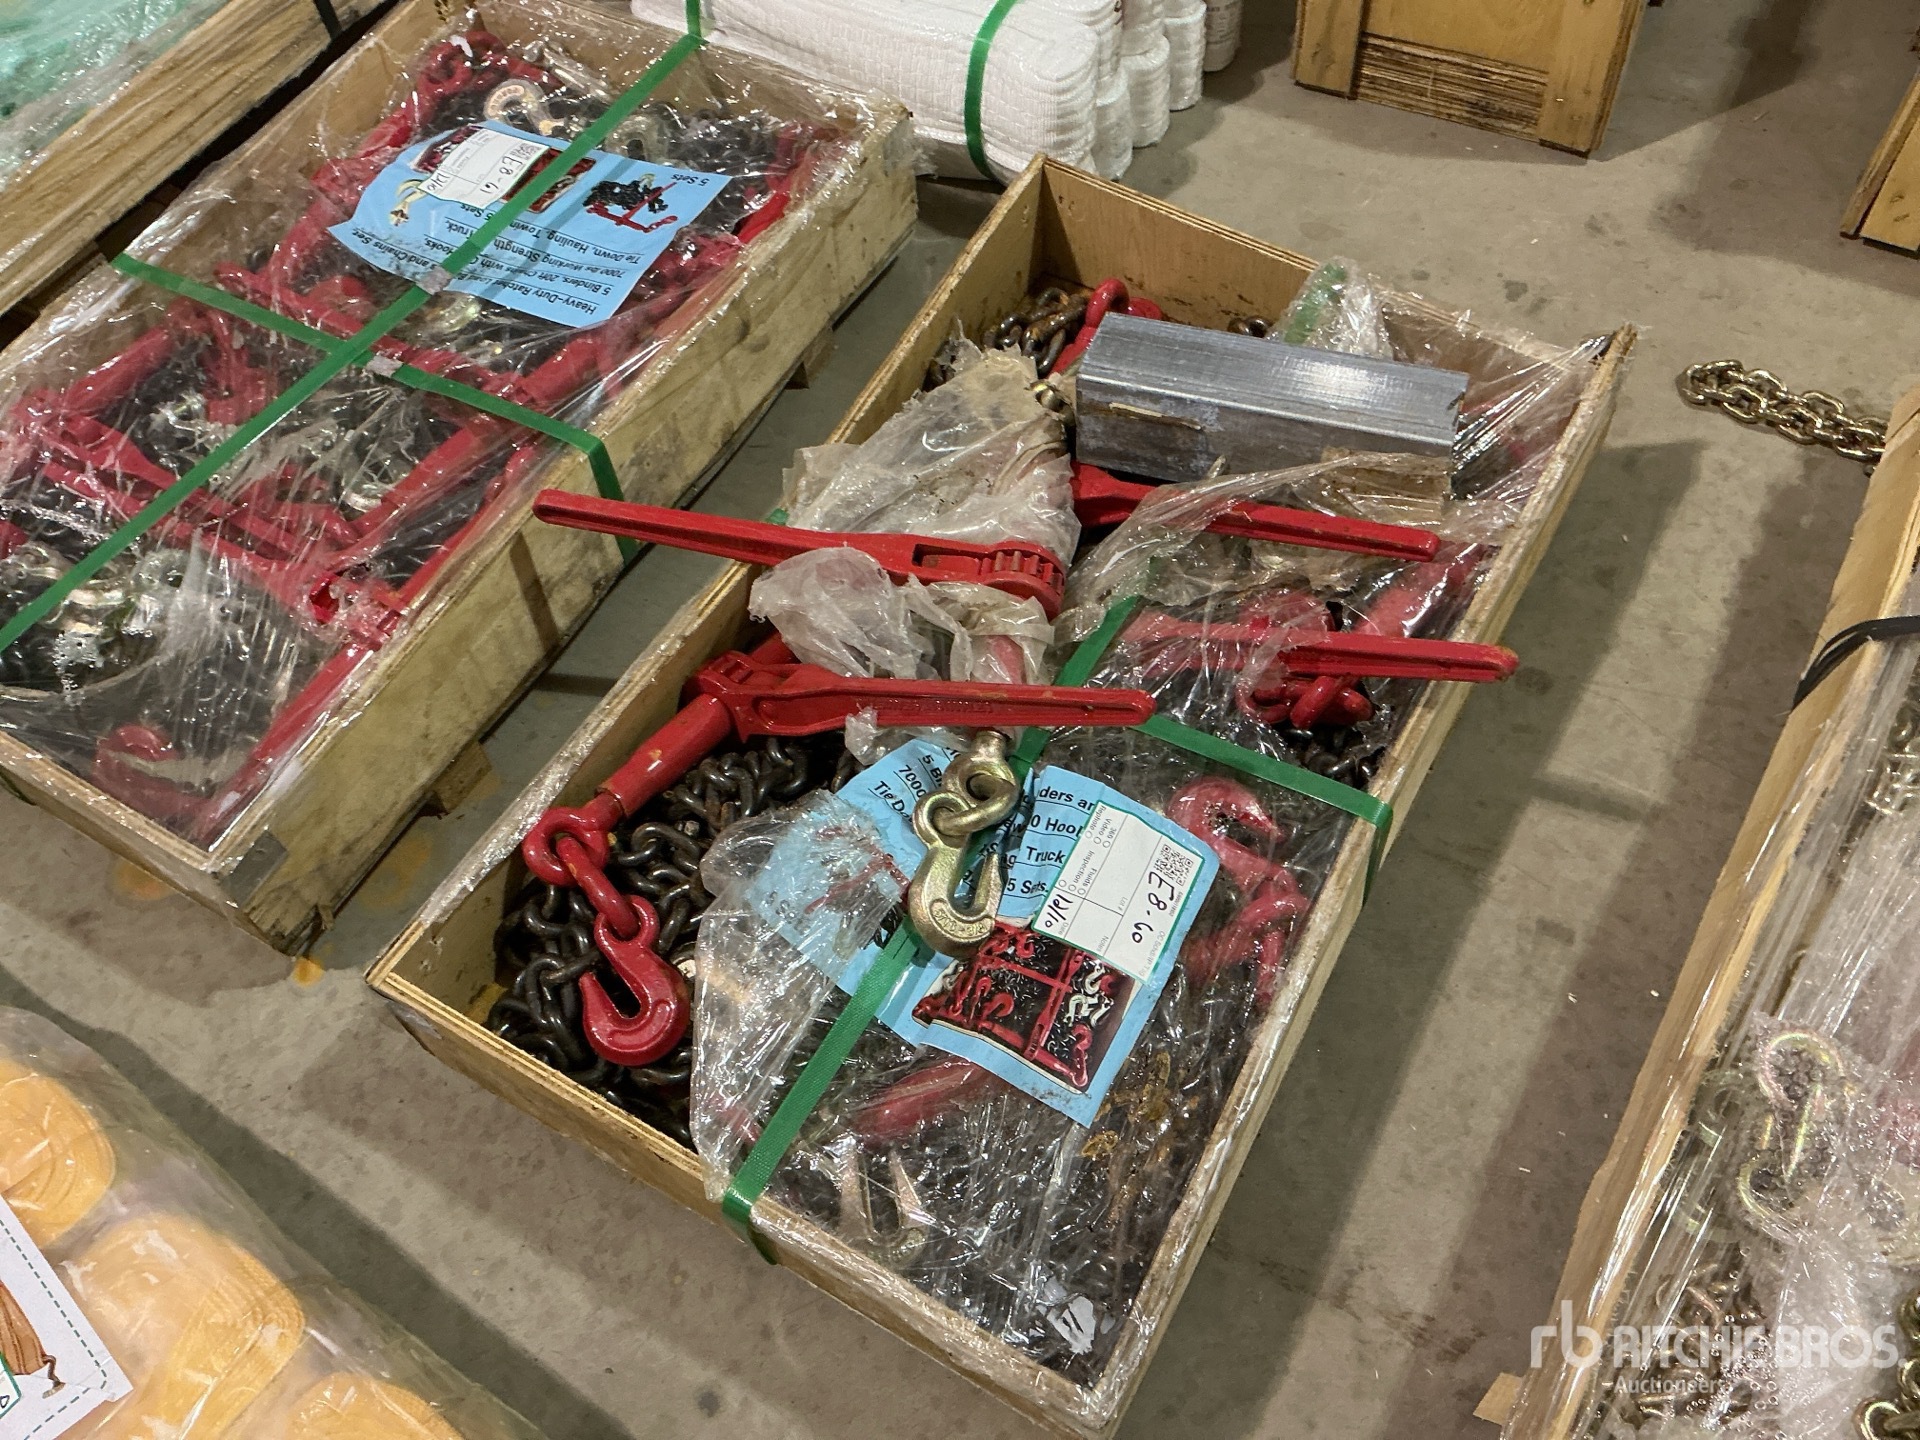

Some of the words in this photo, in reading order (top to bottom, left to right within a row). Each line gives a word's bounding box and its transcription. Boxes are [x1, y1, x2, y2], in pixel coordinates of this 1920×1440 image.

[670, 174, 698, 185] Sets
[698, 178, 710, 187] 5
[509, 222, 542, 239] Towin
[373, 241, 408, 260] Chains
[546, 230, 589, 255] Hauling,
[493, 239, 540, 263] Strength
[593, 247, 623, 262] Down,
[408, 255, 430, 268] and
[480, 258, 504, 271] with
[542, 254, 583, 273] Working
[626, 255, 642, 265] Tie
[538, 271, 560, 283] 20ft
[600, 269, 626, 279] 7000
[492, 280, 532, 296] Ratchet
[601, 287, 612, 297] 5
[532, 289, 597, 316] Heavy-Duty
[922, 754, 935, 765] 5
[899, 764, 927, 798] 7000
[874, 780, 894, 800] Tie
[1099, 818, 1112, 836] Video
[1073, 850, 1095, 884] Inspection
[1007, 878, 1016, 892] 5
[1082, 867, 1097, 887] Fluids
